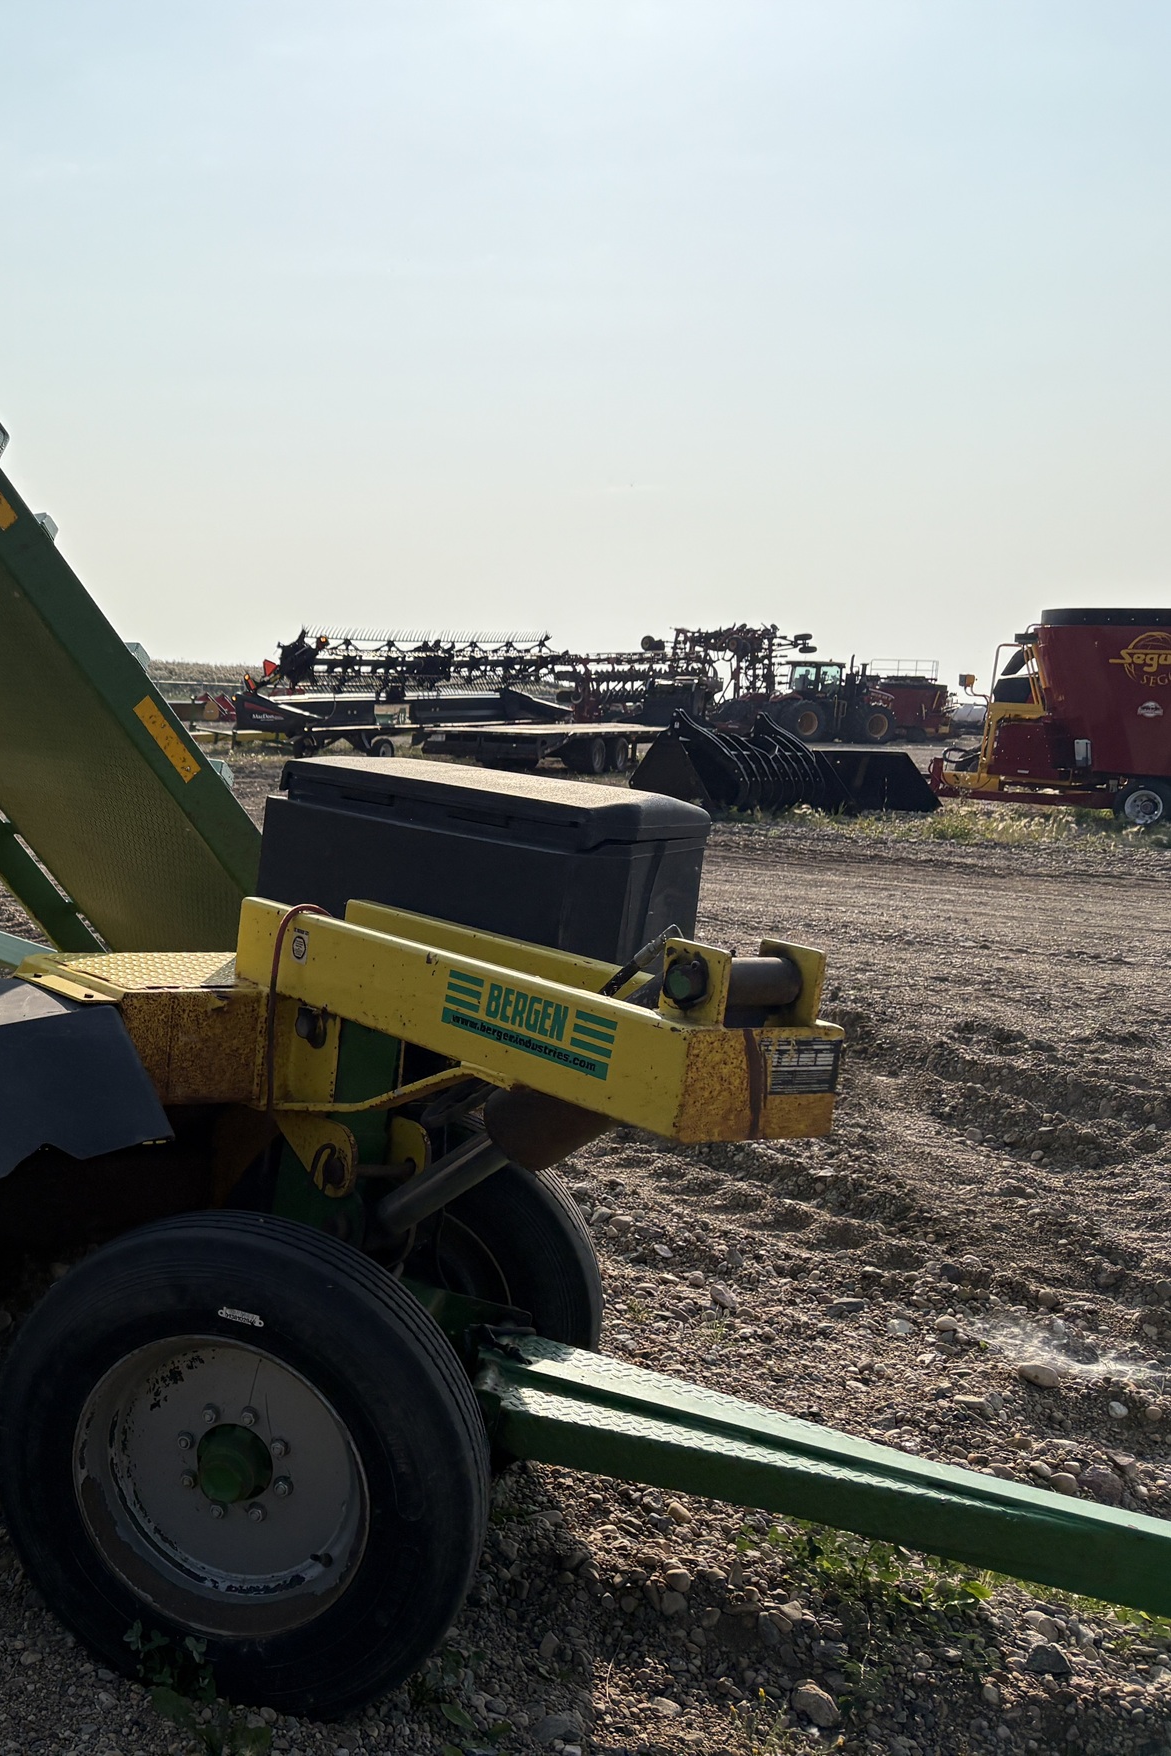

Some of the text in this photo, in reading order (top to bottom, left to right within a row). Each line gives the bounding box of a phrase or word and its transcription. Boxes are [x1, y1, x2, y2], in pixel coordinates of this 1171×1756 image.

[1140, 673, 1171, 687] SEG
[485, 983, 569, 1042] BERGEN
[452, 1014, 596, 1072] www.bergenindustries.com
